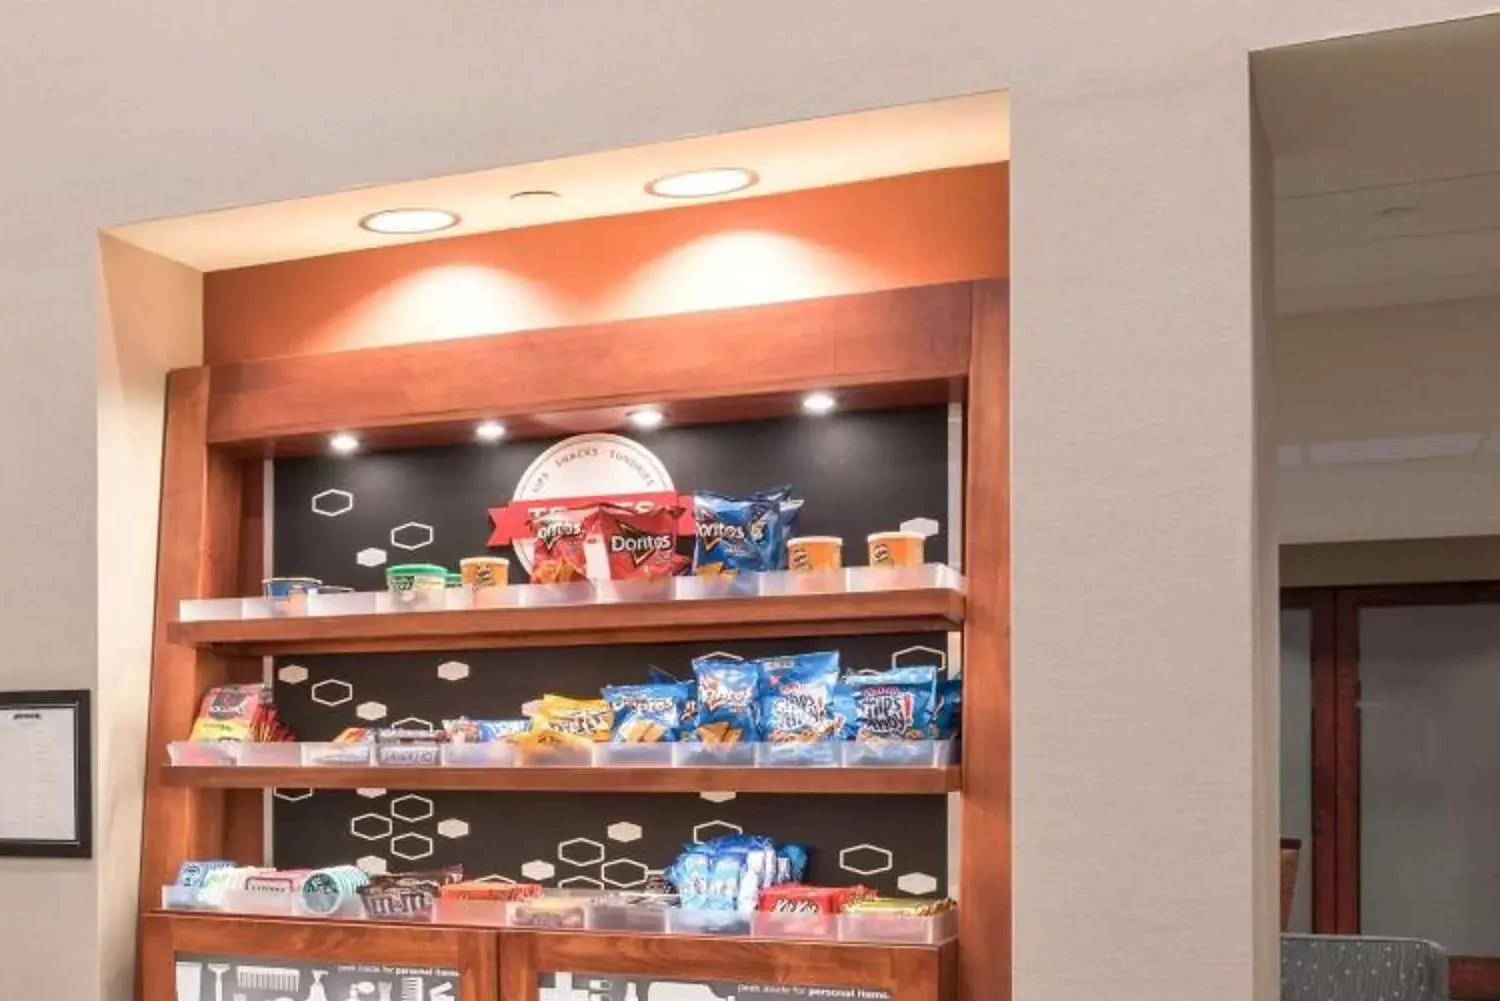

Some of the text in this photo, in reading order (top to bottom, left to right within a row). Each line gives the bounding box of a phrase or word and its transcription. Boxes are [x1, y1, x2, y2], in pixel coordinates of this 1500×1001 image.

[538, 522, 581, 539] oritos
[611, 534, 671, 551] Doritos
[808, 987, 856, 998] personal
